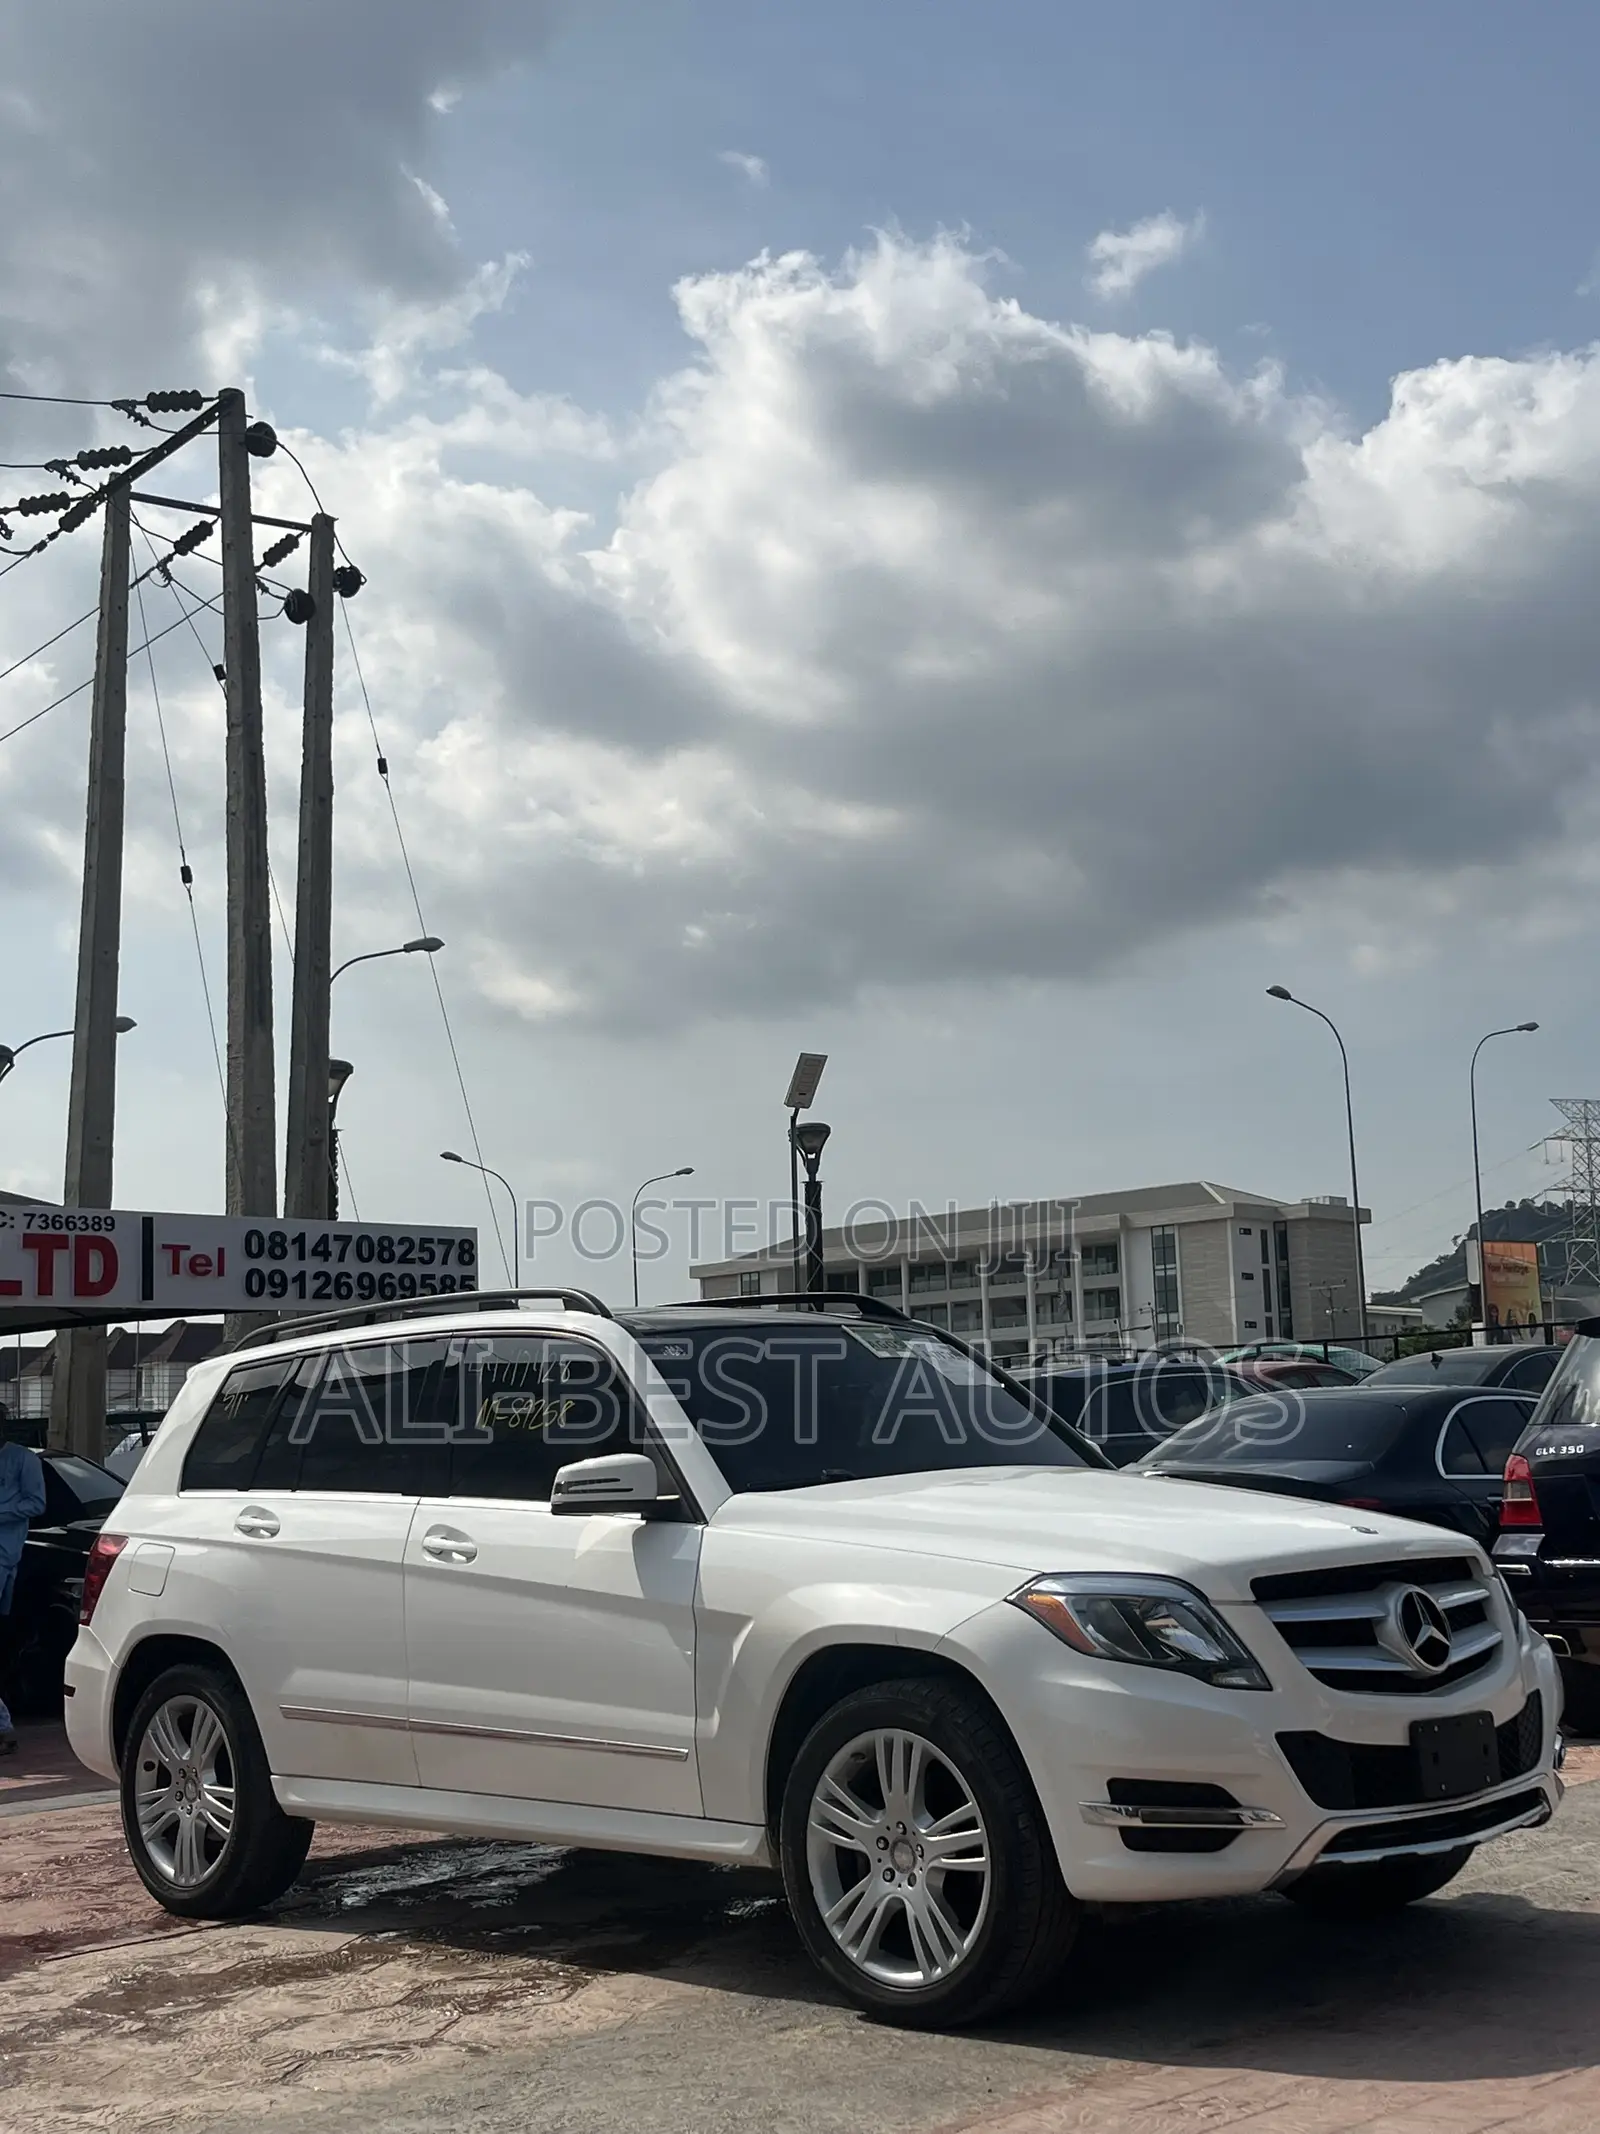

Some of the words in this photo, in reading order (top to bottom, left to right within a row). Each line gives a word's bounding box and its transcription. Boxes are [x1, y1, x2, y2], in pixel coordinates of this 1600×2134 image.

[23, 1213, 116, 1232] 7366389
[162, 1243, 226, 1277] Tel
[244, 1229, 476, 1266] 08147082578
[1536, 1446, 1556, 1456] GLK
[1559, 1444, 1584, 1454] 350
